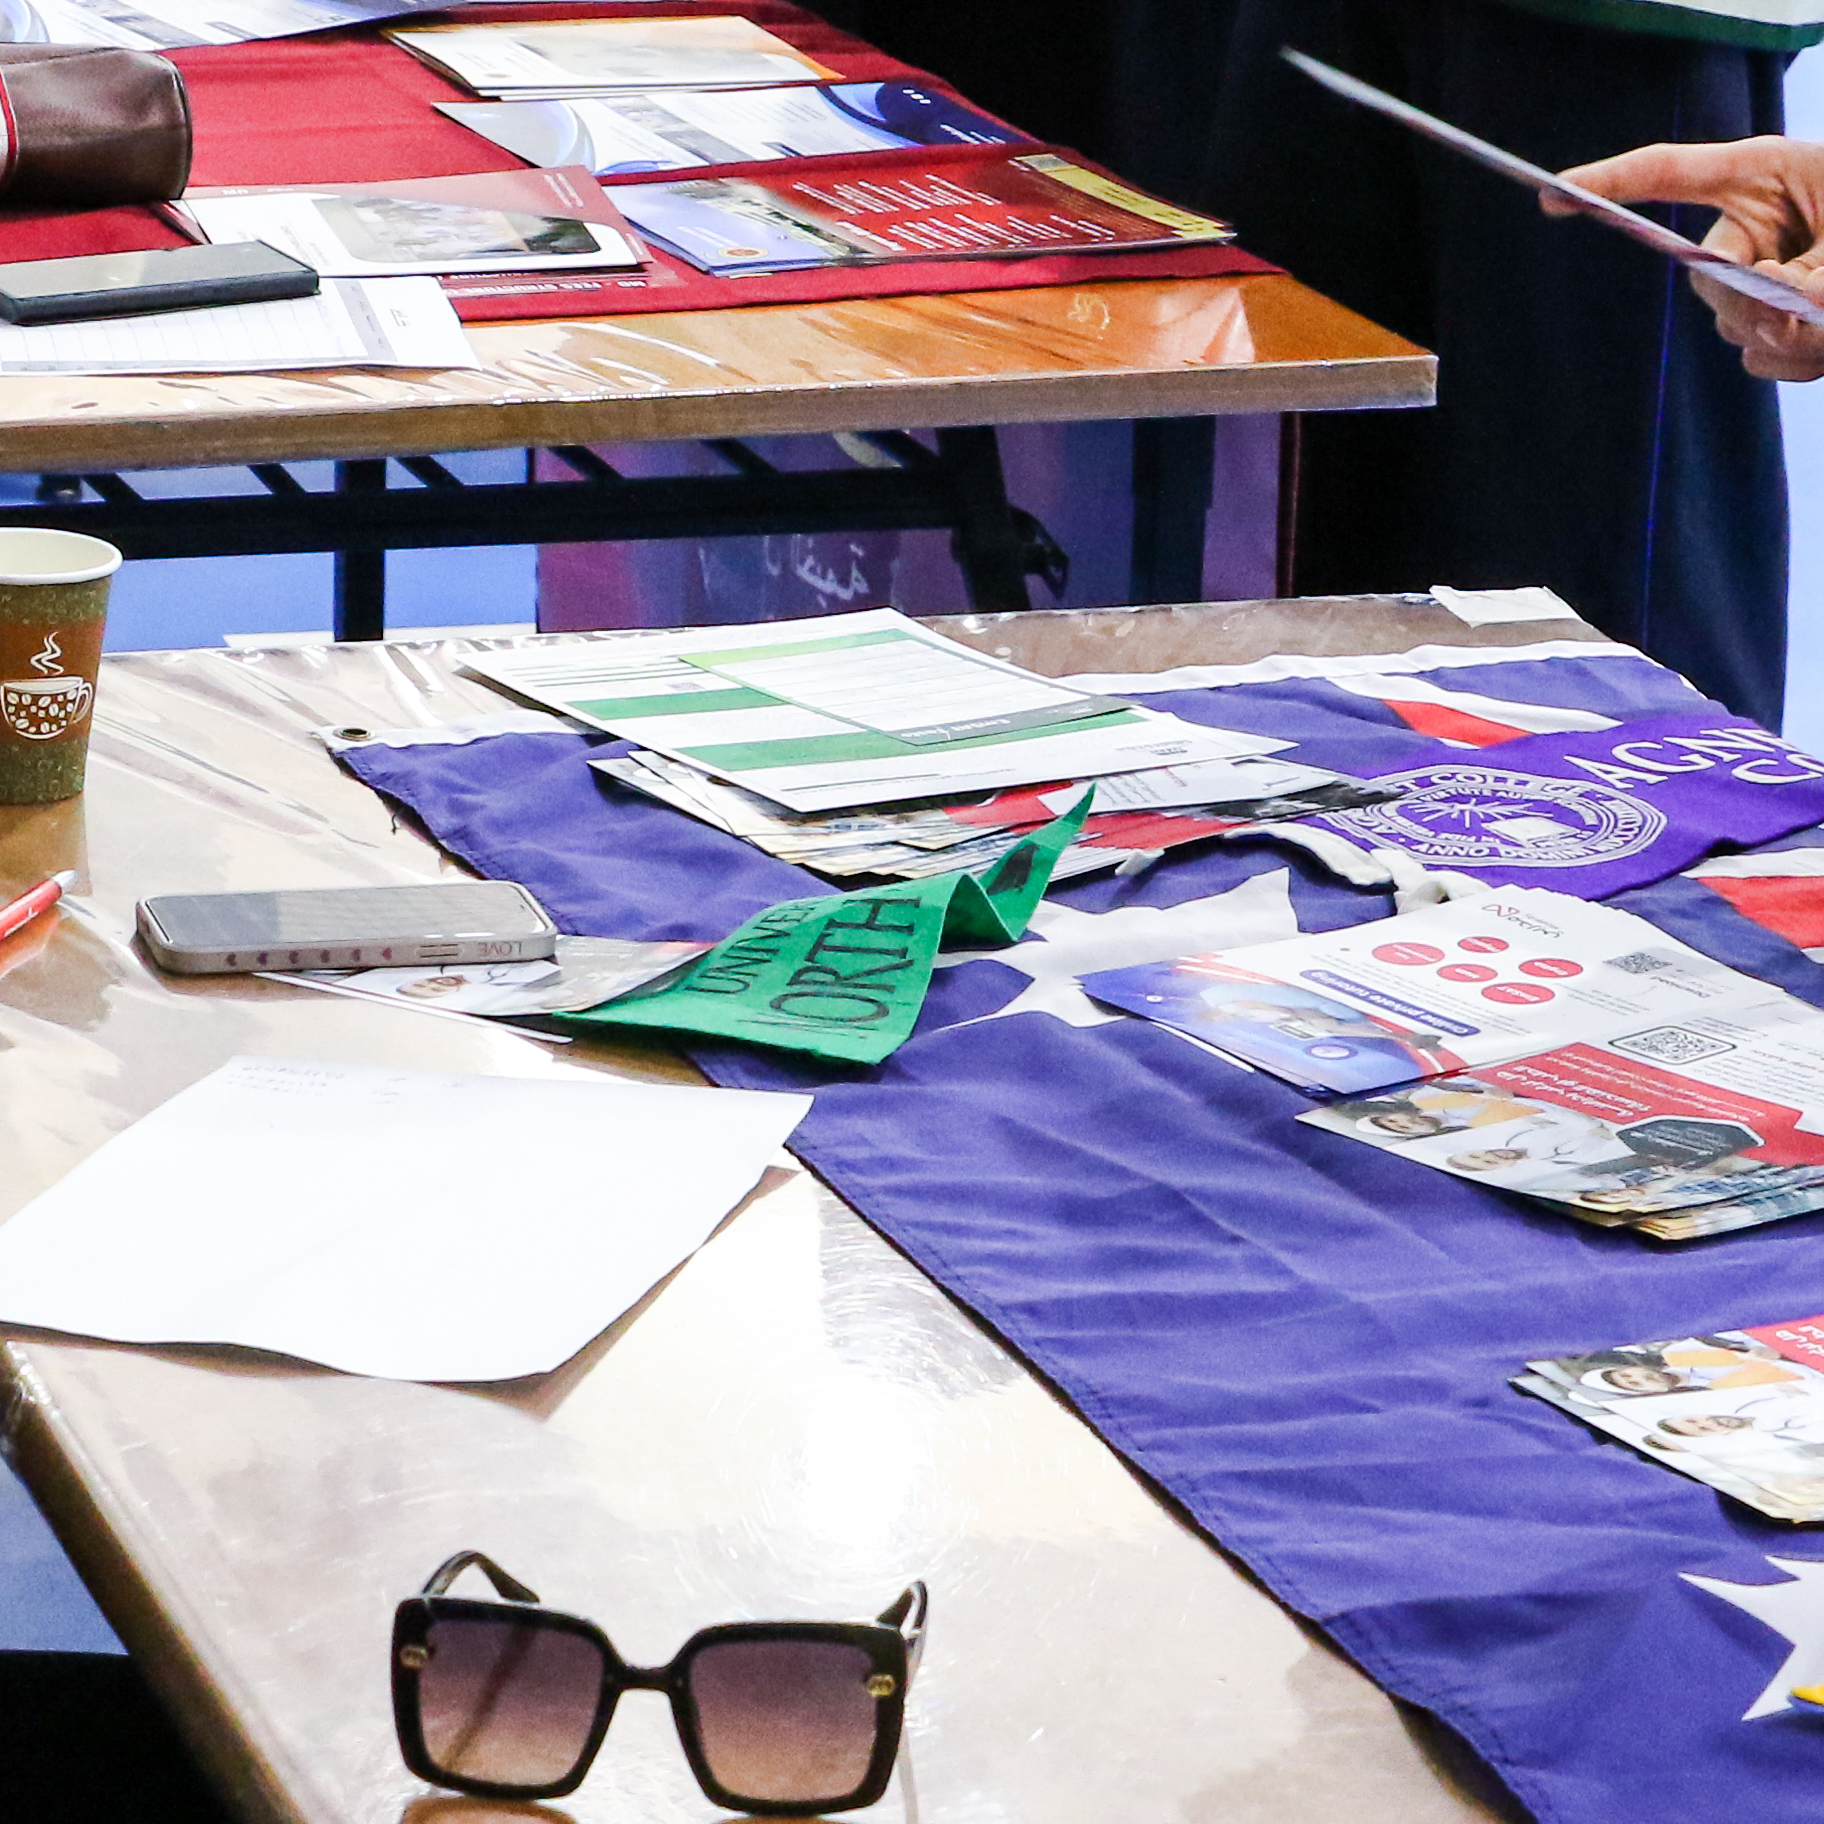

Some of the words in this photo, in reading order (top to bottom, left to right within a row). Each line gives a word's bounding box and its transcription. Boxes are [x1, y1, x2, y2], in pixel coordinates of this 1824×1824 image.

[1409, 843, 1490, 858] ANNO
[479, 940, 523, 957] LOVE
[769, 888, 922, 1023] ORTH
